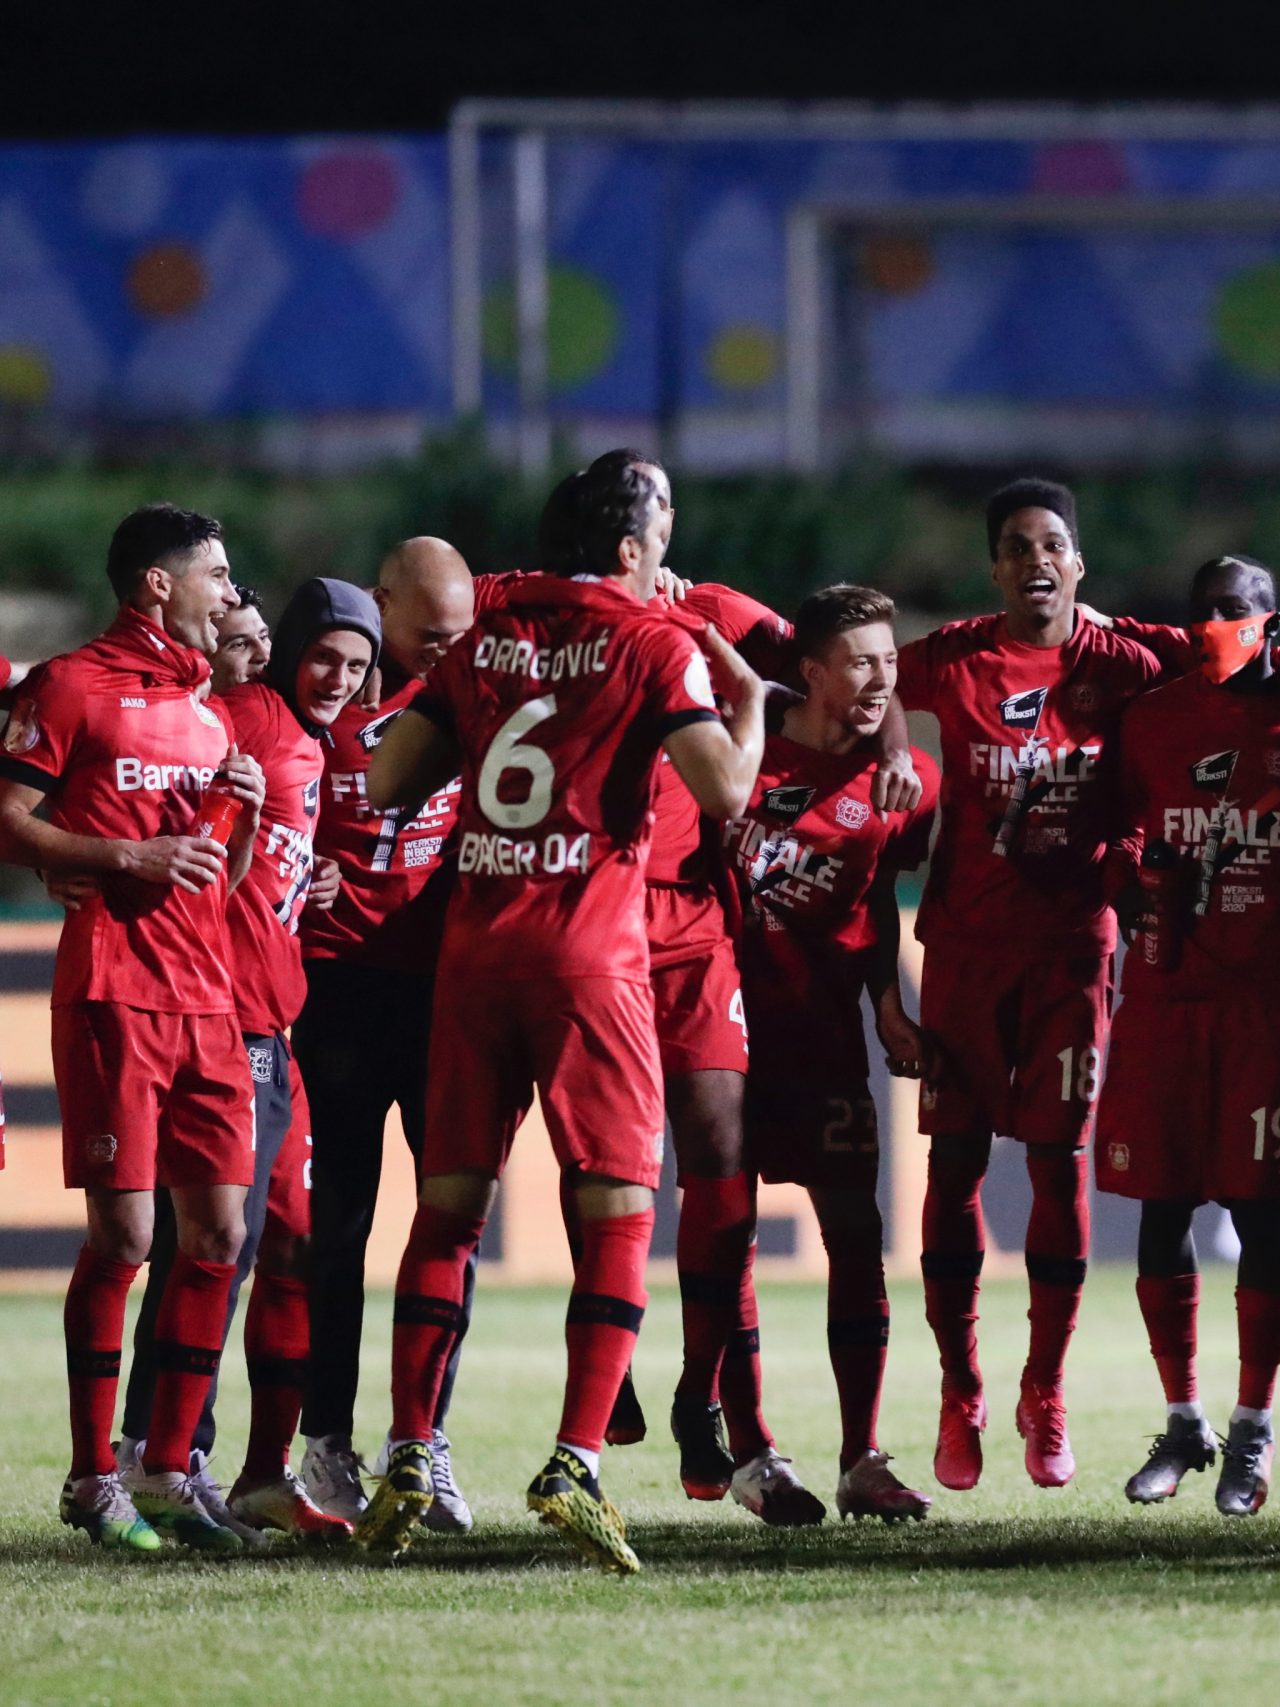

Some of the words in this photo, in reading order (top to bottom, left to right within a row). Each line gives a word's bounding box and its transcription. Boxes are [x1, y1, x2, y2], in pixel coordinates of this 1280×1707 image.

[474, 628, 609, 682] DRAGOVIĆ
[120, 697, 147, 709] JAKO
[115, 756, 219, 792] Barme
[477, 693, 557, 829] 6
[969, 742, 1101, 783] FINALE
[404, 848, 414, 858] IN
[404, 856, 430, 868] 2020
[543, 832, 590, 875] 04
[722, 817, 844, 893] FINALE
[1221, 903, 1246, 913] 2020
[1232, 895, 1265, 904] BERLIN
[1056, 1046, 1100, 1102] 18
